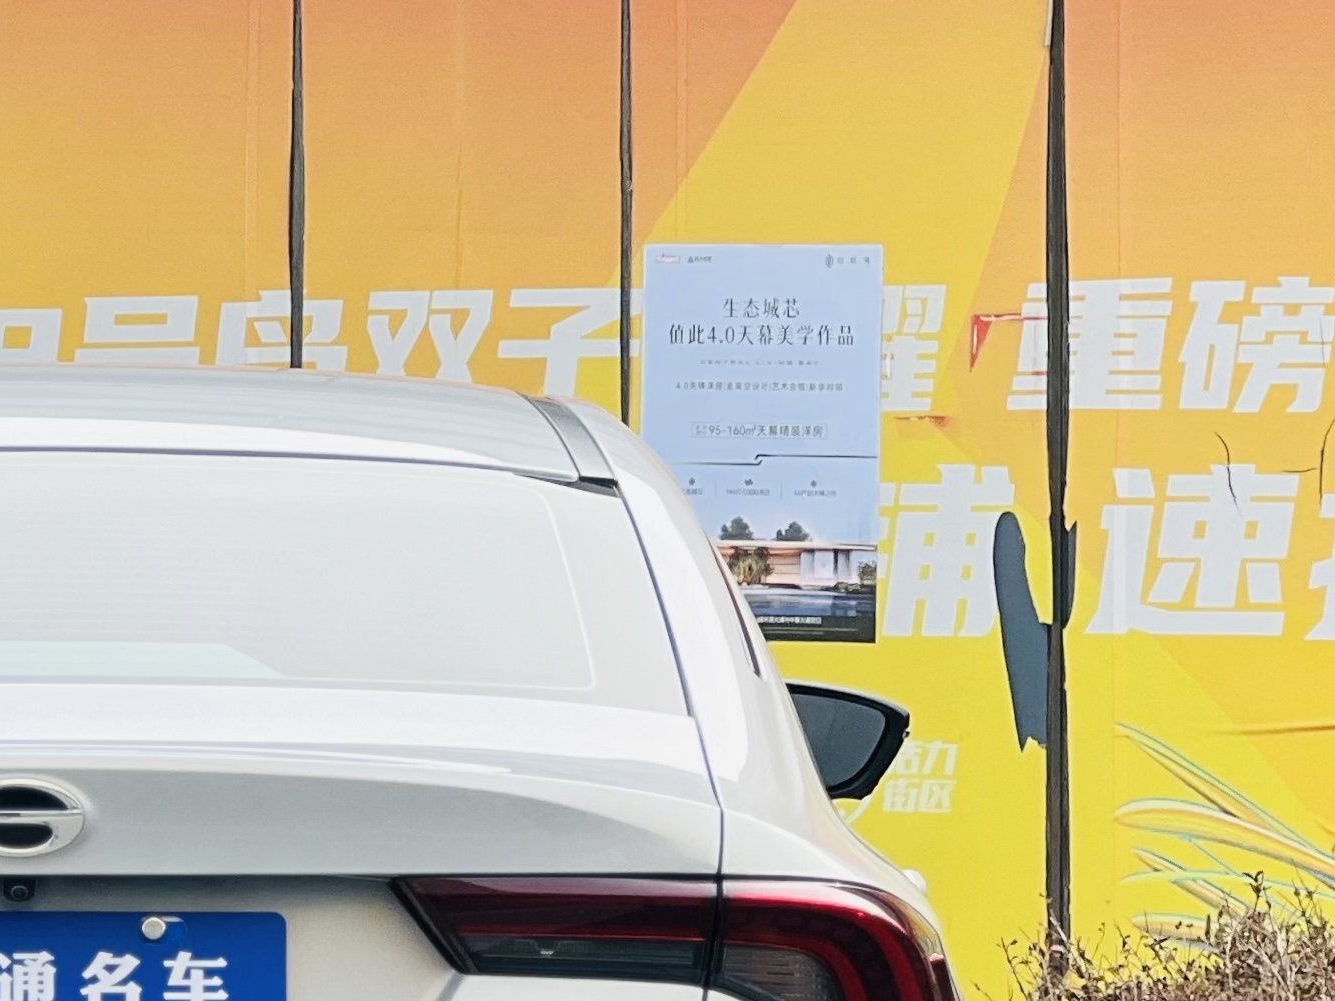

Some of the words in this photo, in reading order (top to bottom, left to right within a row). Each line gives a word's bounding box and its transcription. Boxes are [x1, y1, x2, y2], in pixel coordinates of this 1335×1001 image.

[723, 297, 800, 319] 生态城芯
[668, 323, 854, 346] 值此4.0天幕美学作品
[883, 778, 956, 814] 街区
